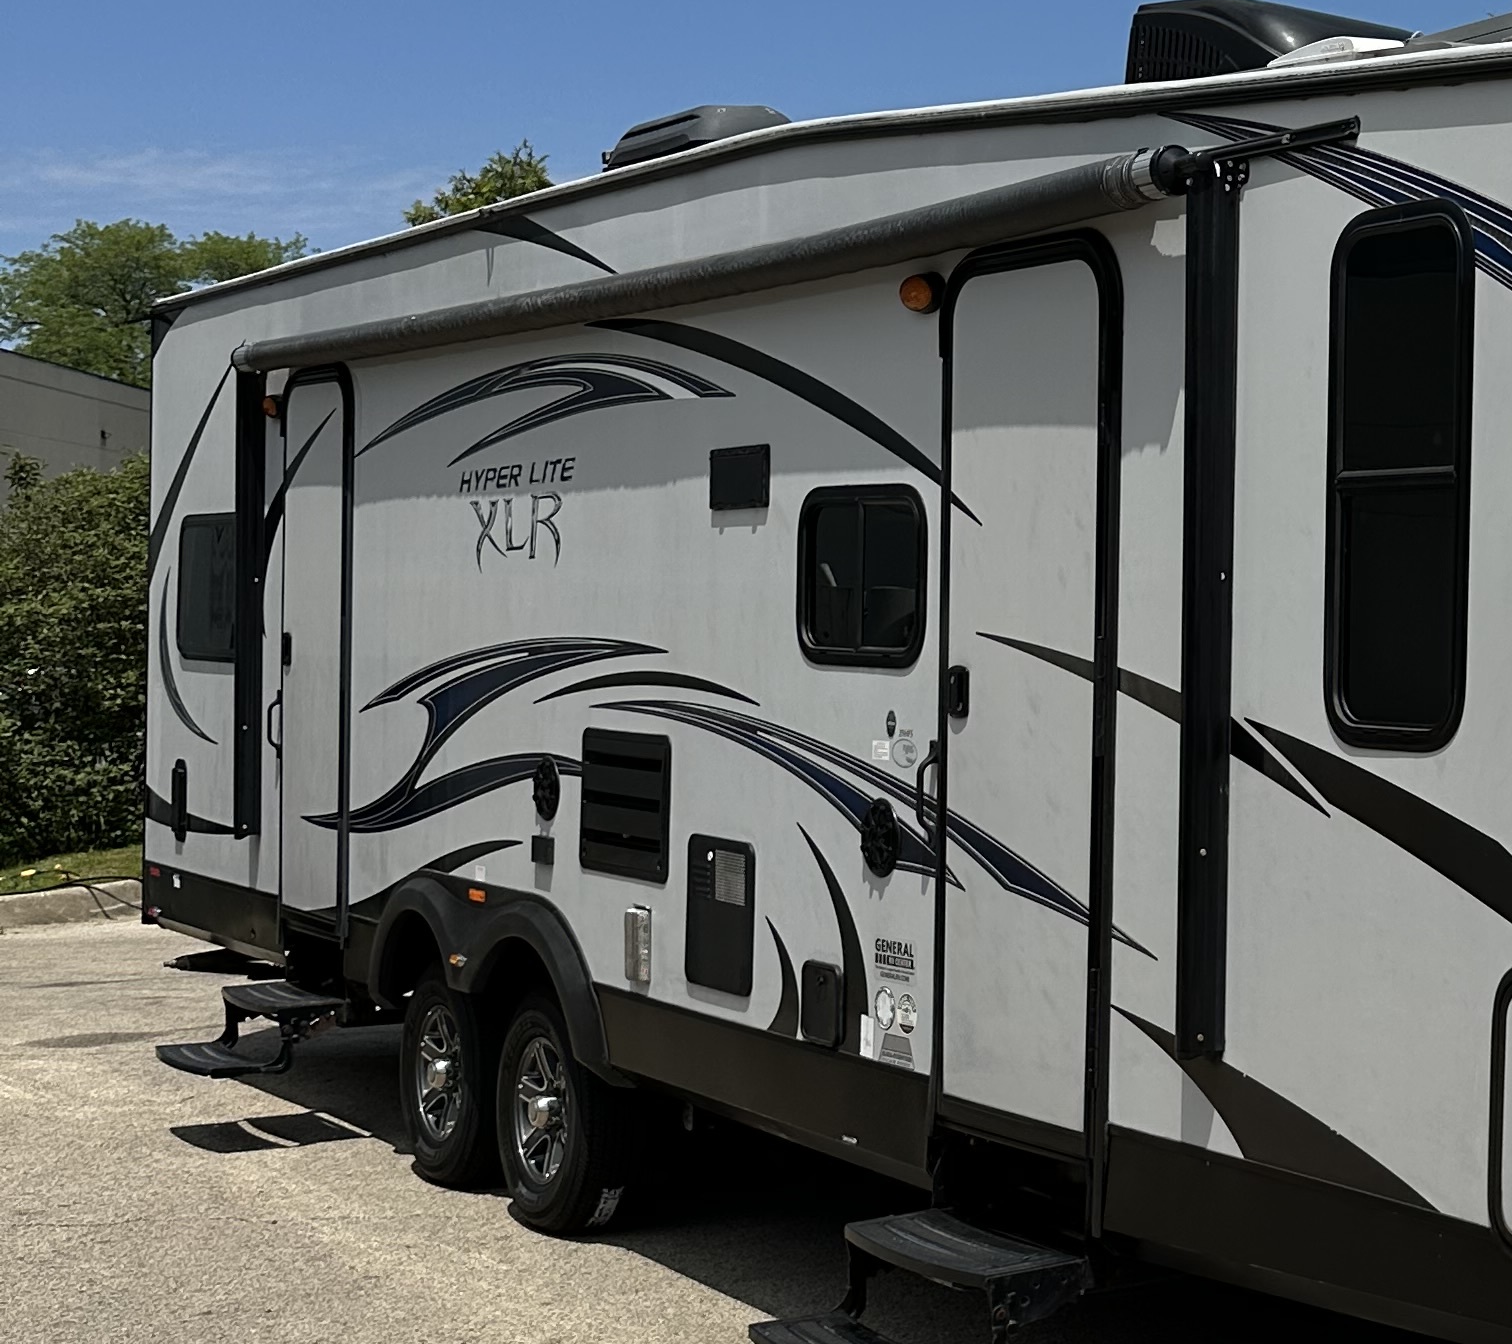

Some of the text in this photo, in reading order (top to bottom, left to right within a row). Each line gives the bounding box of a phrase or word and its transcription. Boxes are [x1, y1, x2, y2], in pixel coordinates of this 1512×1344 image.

[459, 457, 576, 493] HYPER LITE
[469, 491, 563, 574] XLR
[874, 937, 914, 958] GENERAL
